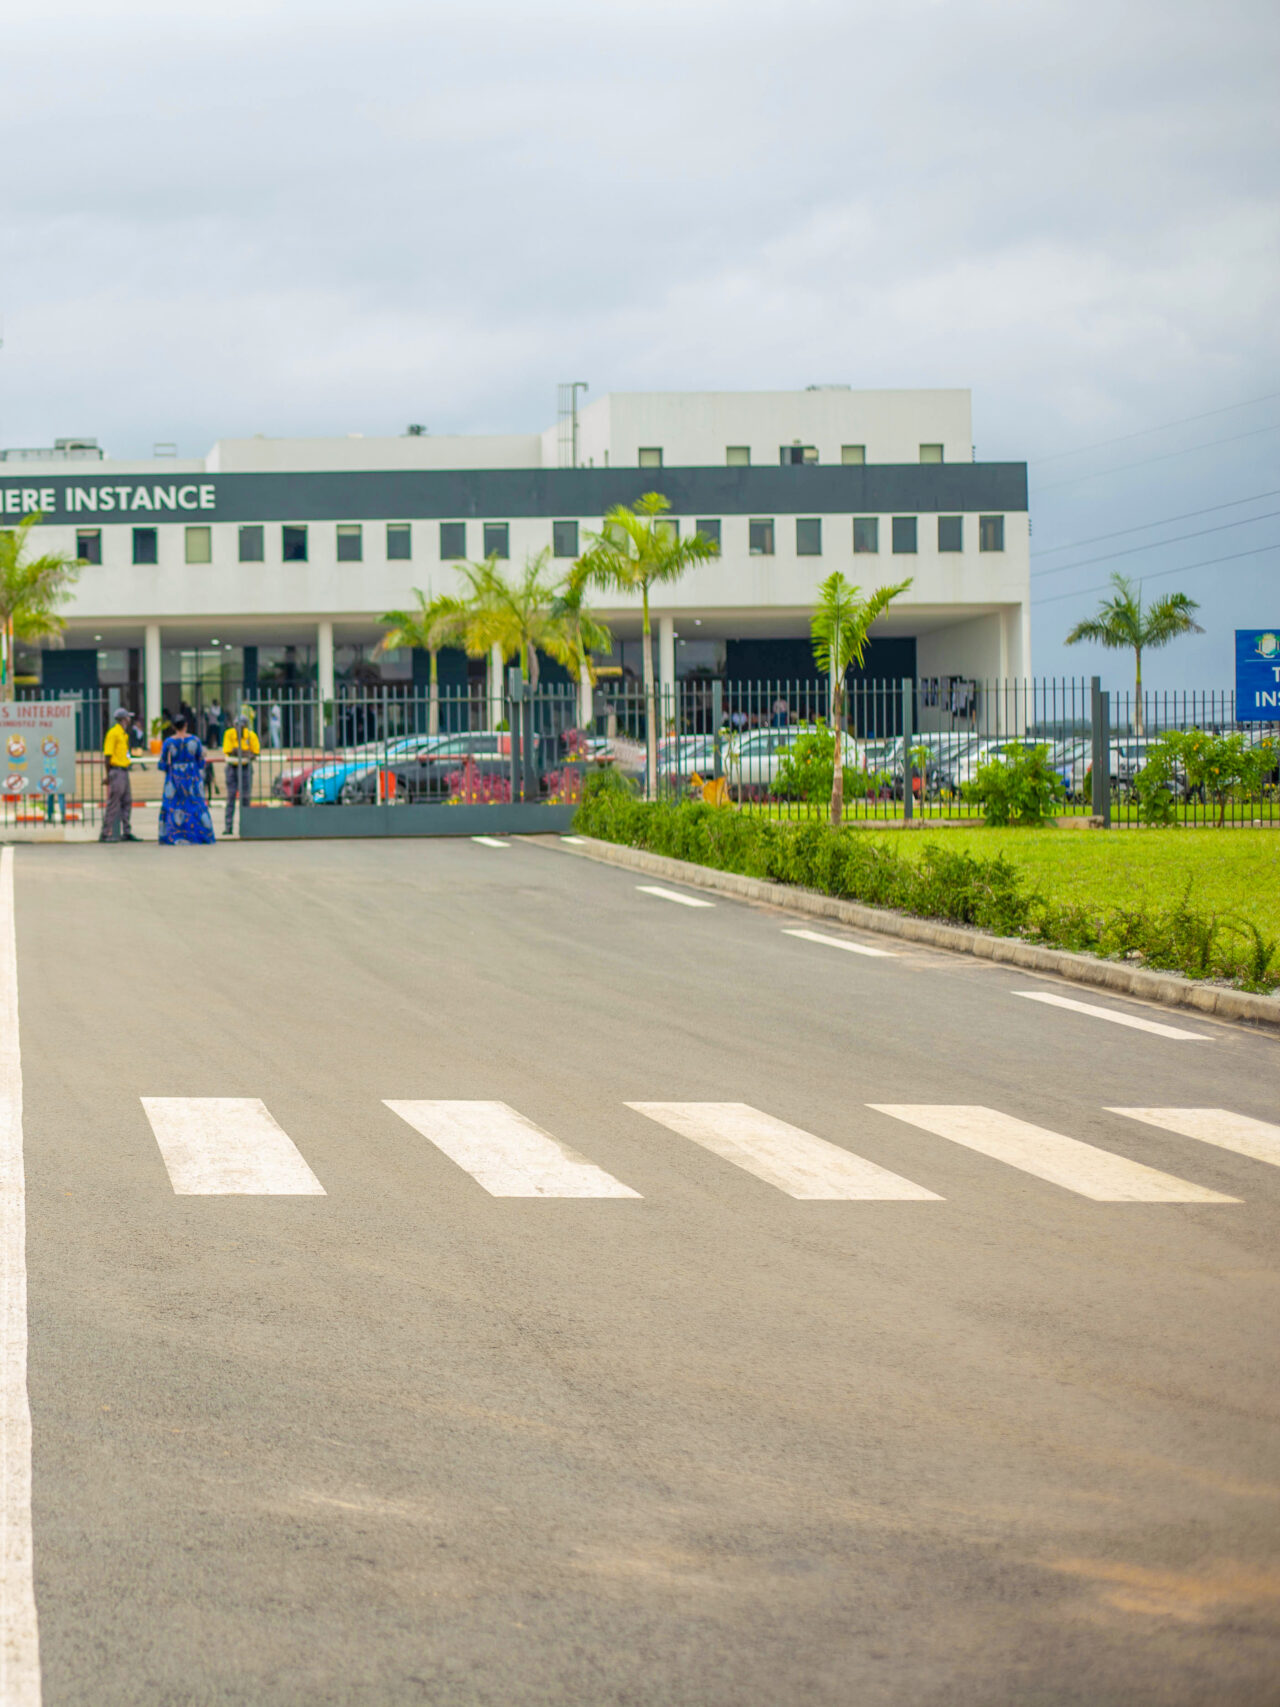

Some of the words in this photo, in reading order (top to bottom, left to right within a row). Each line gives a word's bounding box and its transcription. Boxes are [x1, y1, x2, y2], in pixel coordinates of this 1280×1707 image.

[65, 484, 216, 511] INSTANCE
[1255, 691, 1280, 707] IN
[17, 705, 72, 718] INTERDIT
